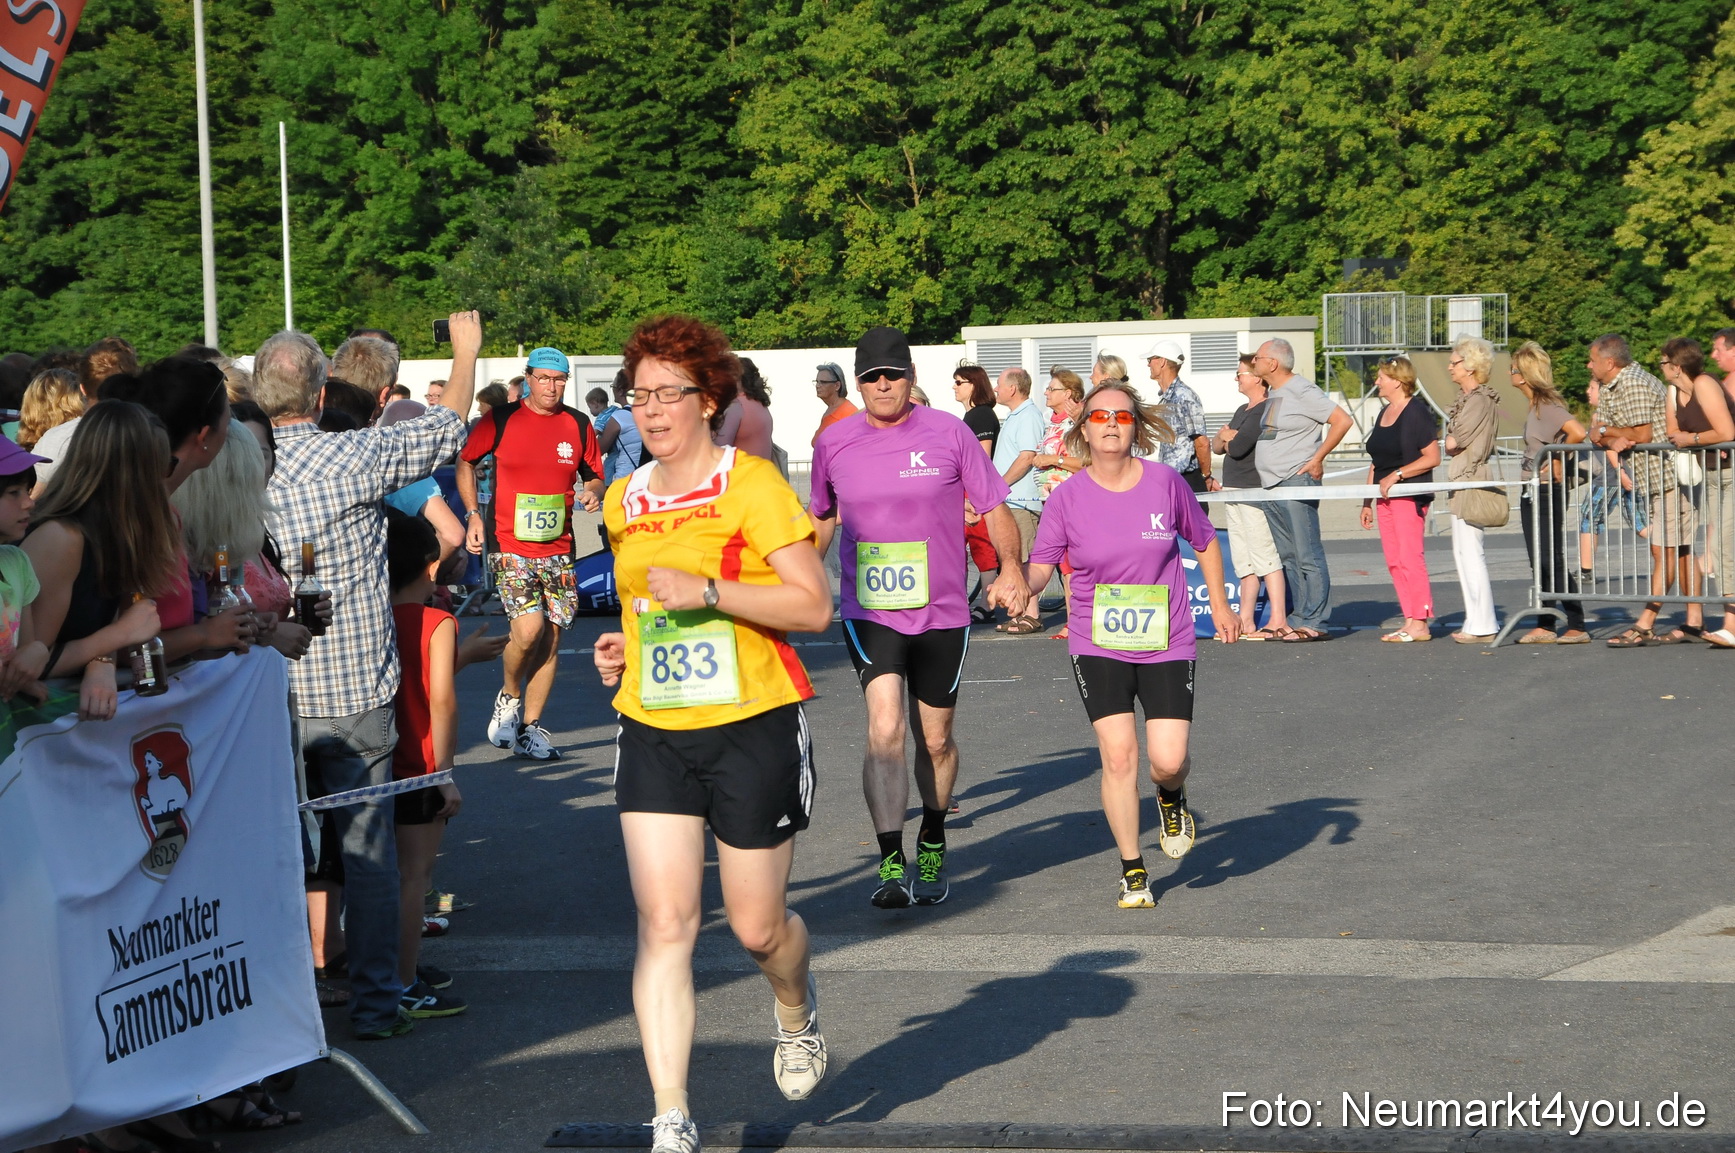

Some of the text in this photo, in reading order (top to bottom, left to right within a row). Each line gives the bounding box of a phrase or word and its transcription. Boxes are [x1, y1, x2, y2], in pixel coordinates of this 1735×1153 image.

[910, 451, 928, 468] K
[523, 511, 558, 530] 153
[1150, 513, 1166, 530] K
[866, 566, 916, 592] 606
[1103, 607, 1156, 634] 607
[652, 641, 719, 684] 833
[1075, 664, 1088, 699] odlo
[107, 895, 221, 976] Neumarkter
[95, 945, 253, 1064] Lammsbräu
